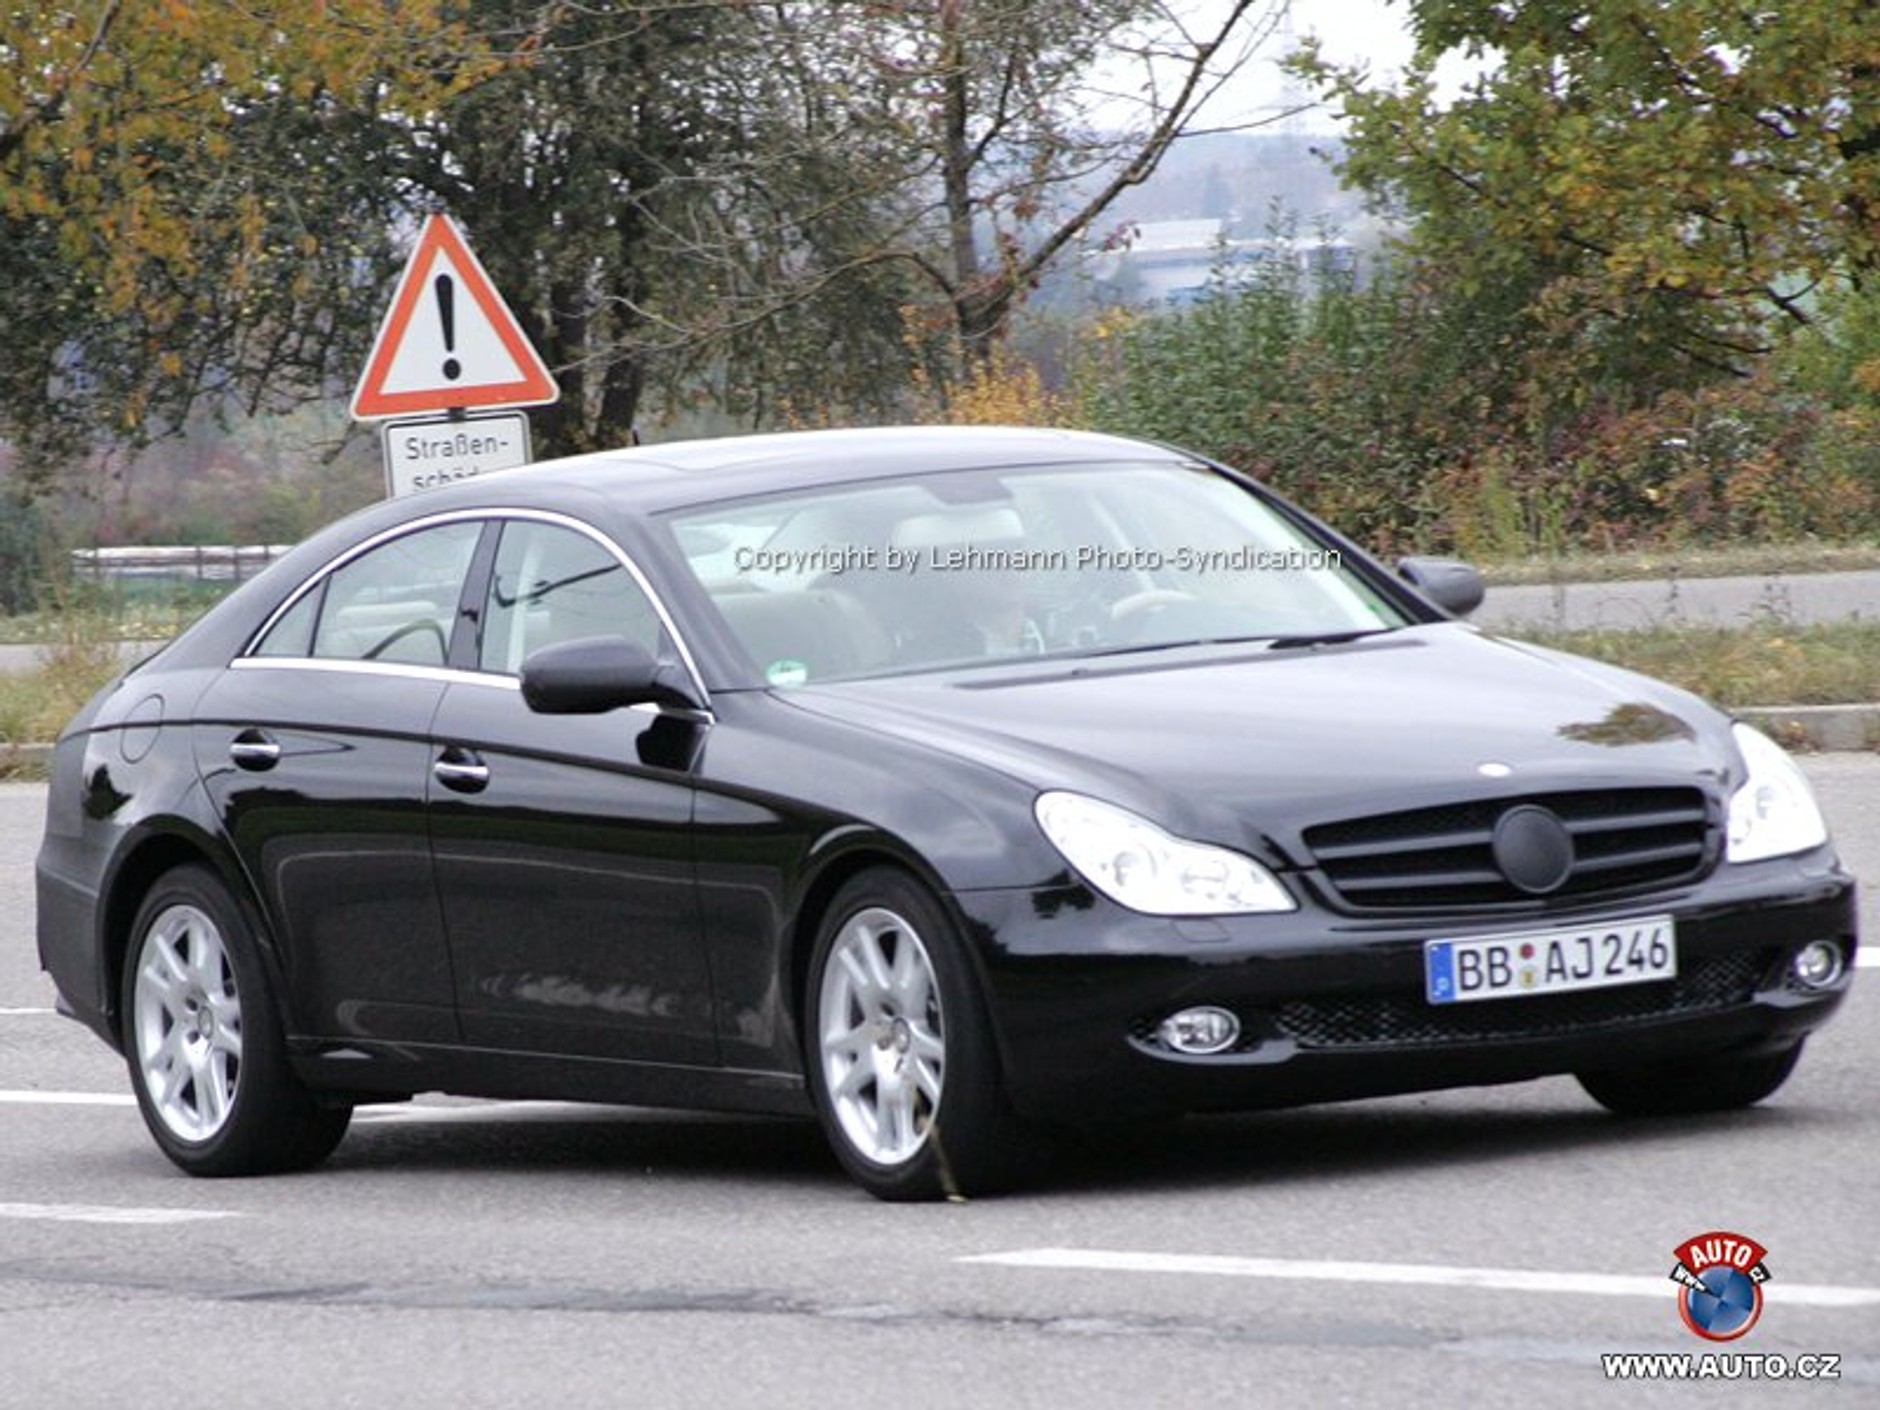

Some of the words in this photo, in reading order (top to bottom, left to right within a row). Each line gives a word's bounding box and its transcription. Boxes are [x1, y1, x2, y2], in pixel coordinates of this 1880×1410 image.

[405, 432, 509, 460] Straßen-
[1457, 946, 1513, 991] BB
[1545, 938, 1594, 983] AJ
[1603, 928, 1668, 976] 246
